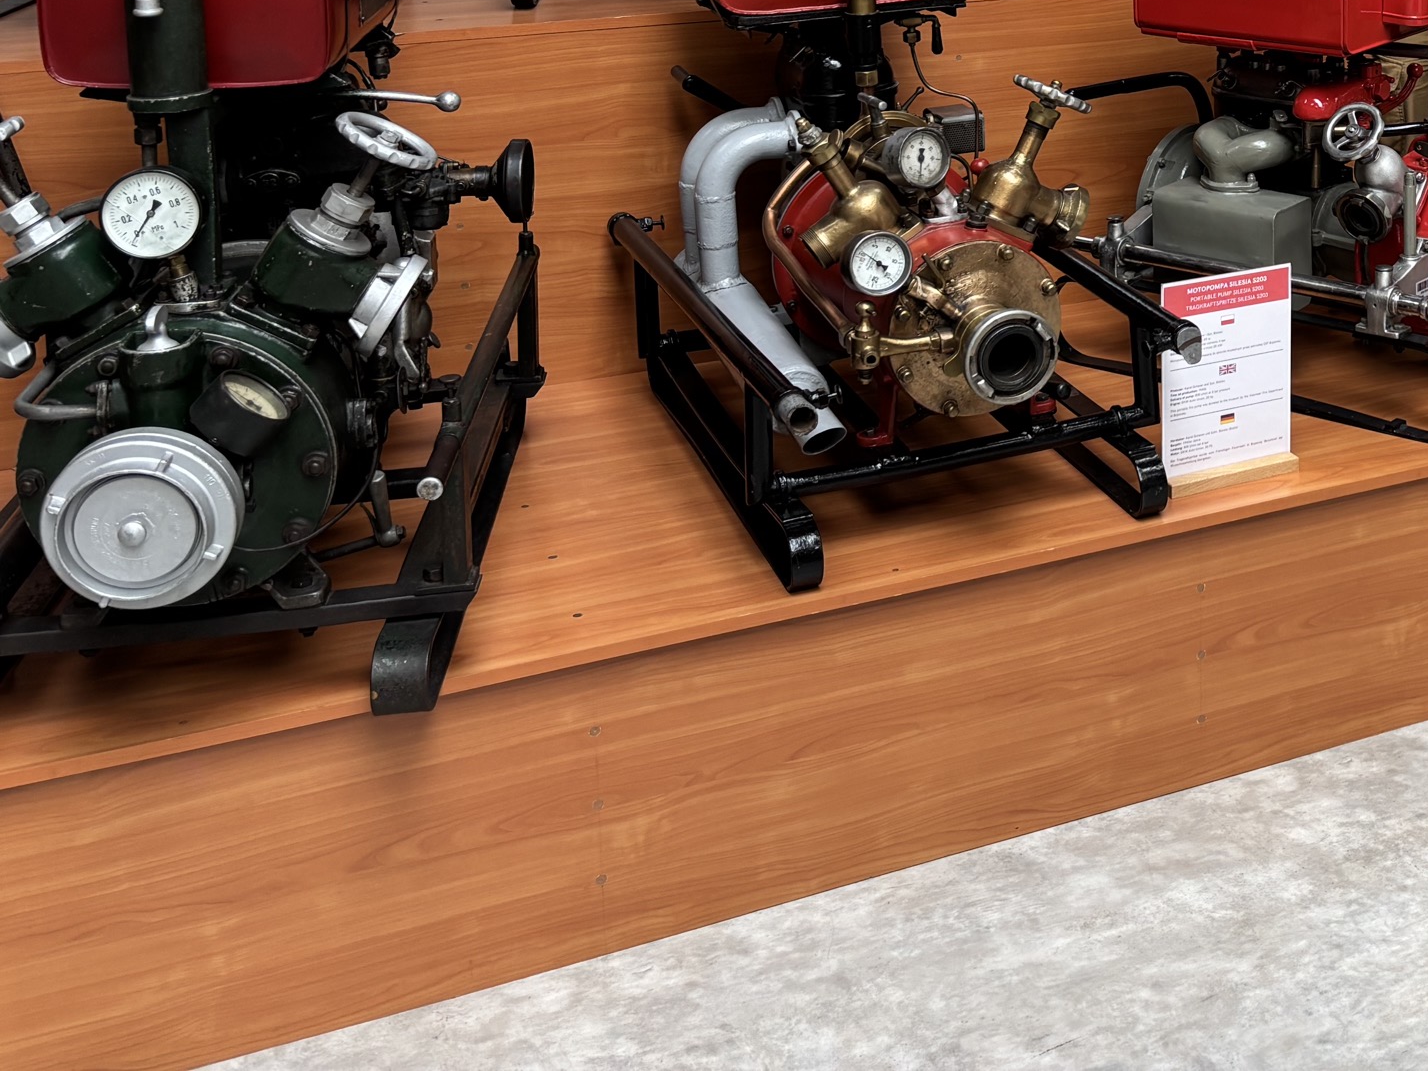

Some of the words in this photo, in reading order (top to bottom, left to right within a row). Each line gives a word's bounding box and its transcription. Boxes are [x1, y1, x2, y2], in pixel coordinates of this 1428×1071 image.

[1187, 283, 1228, 295] MOTOPOMPA
[1229, 279, 1251, 288] SILESIA
[1252, 275, 1267, 283] S203
[1186, 298, 1236, 311] TRAGKRAFTSPRITZE
[1237, 294, 1256, 303] SILESIA
[1190, 294, 1217, 303] PORTABLE
[1217, 290, 1232, 298] PUMP
[1233, 288, 1251, 296] SILESIA
